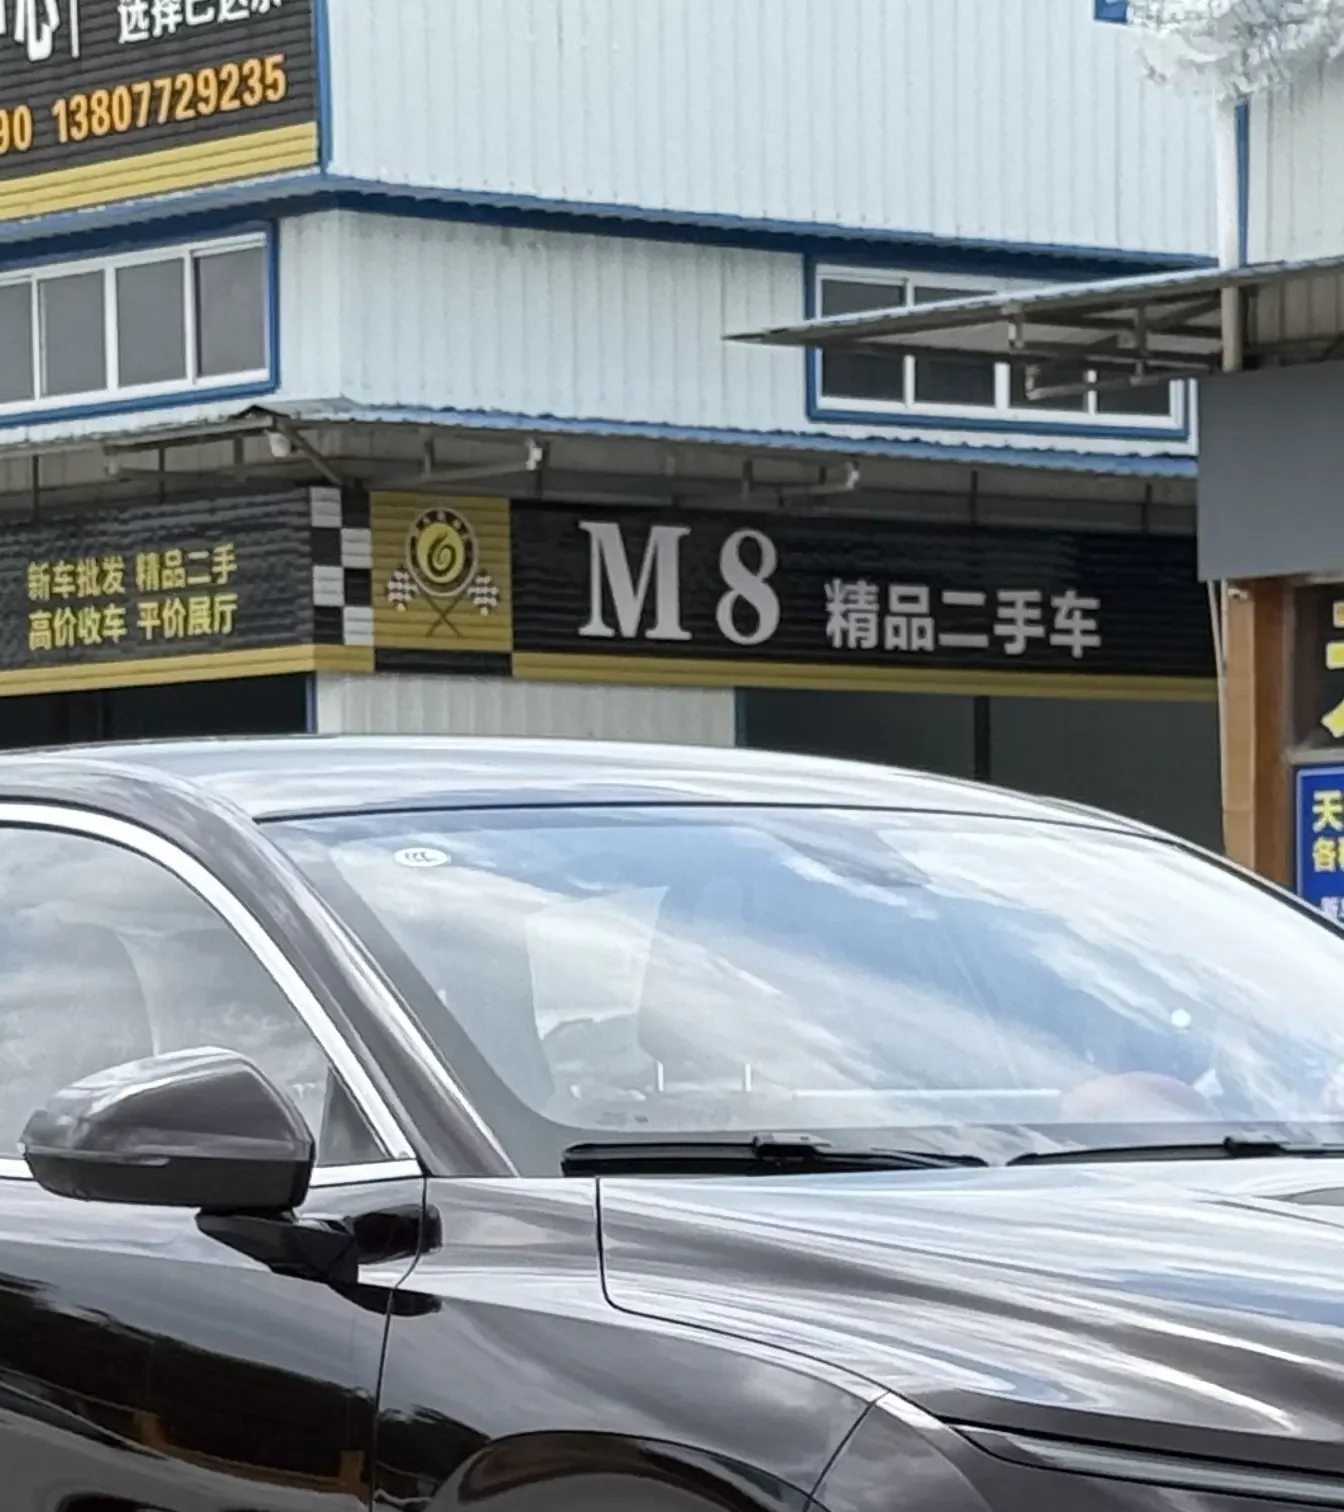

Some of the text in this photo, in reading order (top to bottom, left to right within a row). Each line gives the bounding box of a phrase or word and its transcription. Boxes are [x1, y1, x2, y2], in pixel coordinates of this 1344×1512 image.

[52, 53, 287, 145] 13807729235
[26, 541, 238, 602] 新车批发 精品二手
[577, 520, 1102, 658] M8 精品二手车
[27, 593, 239, 652] 高价收车 平价展厅
